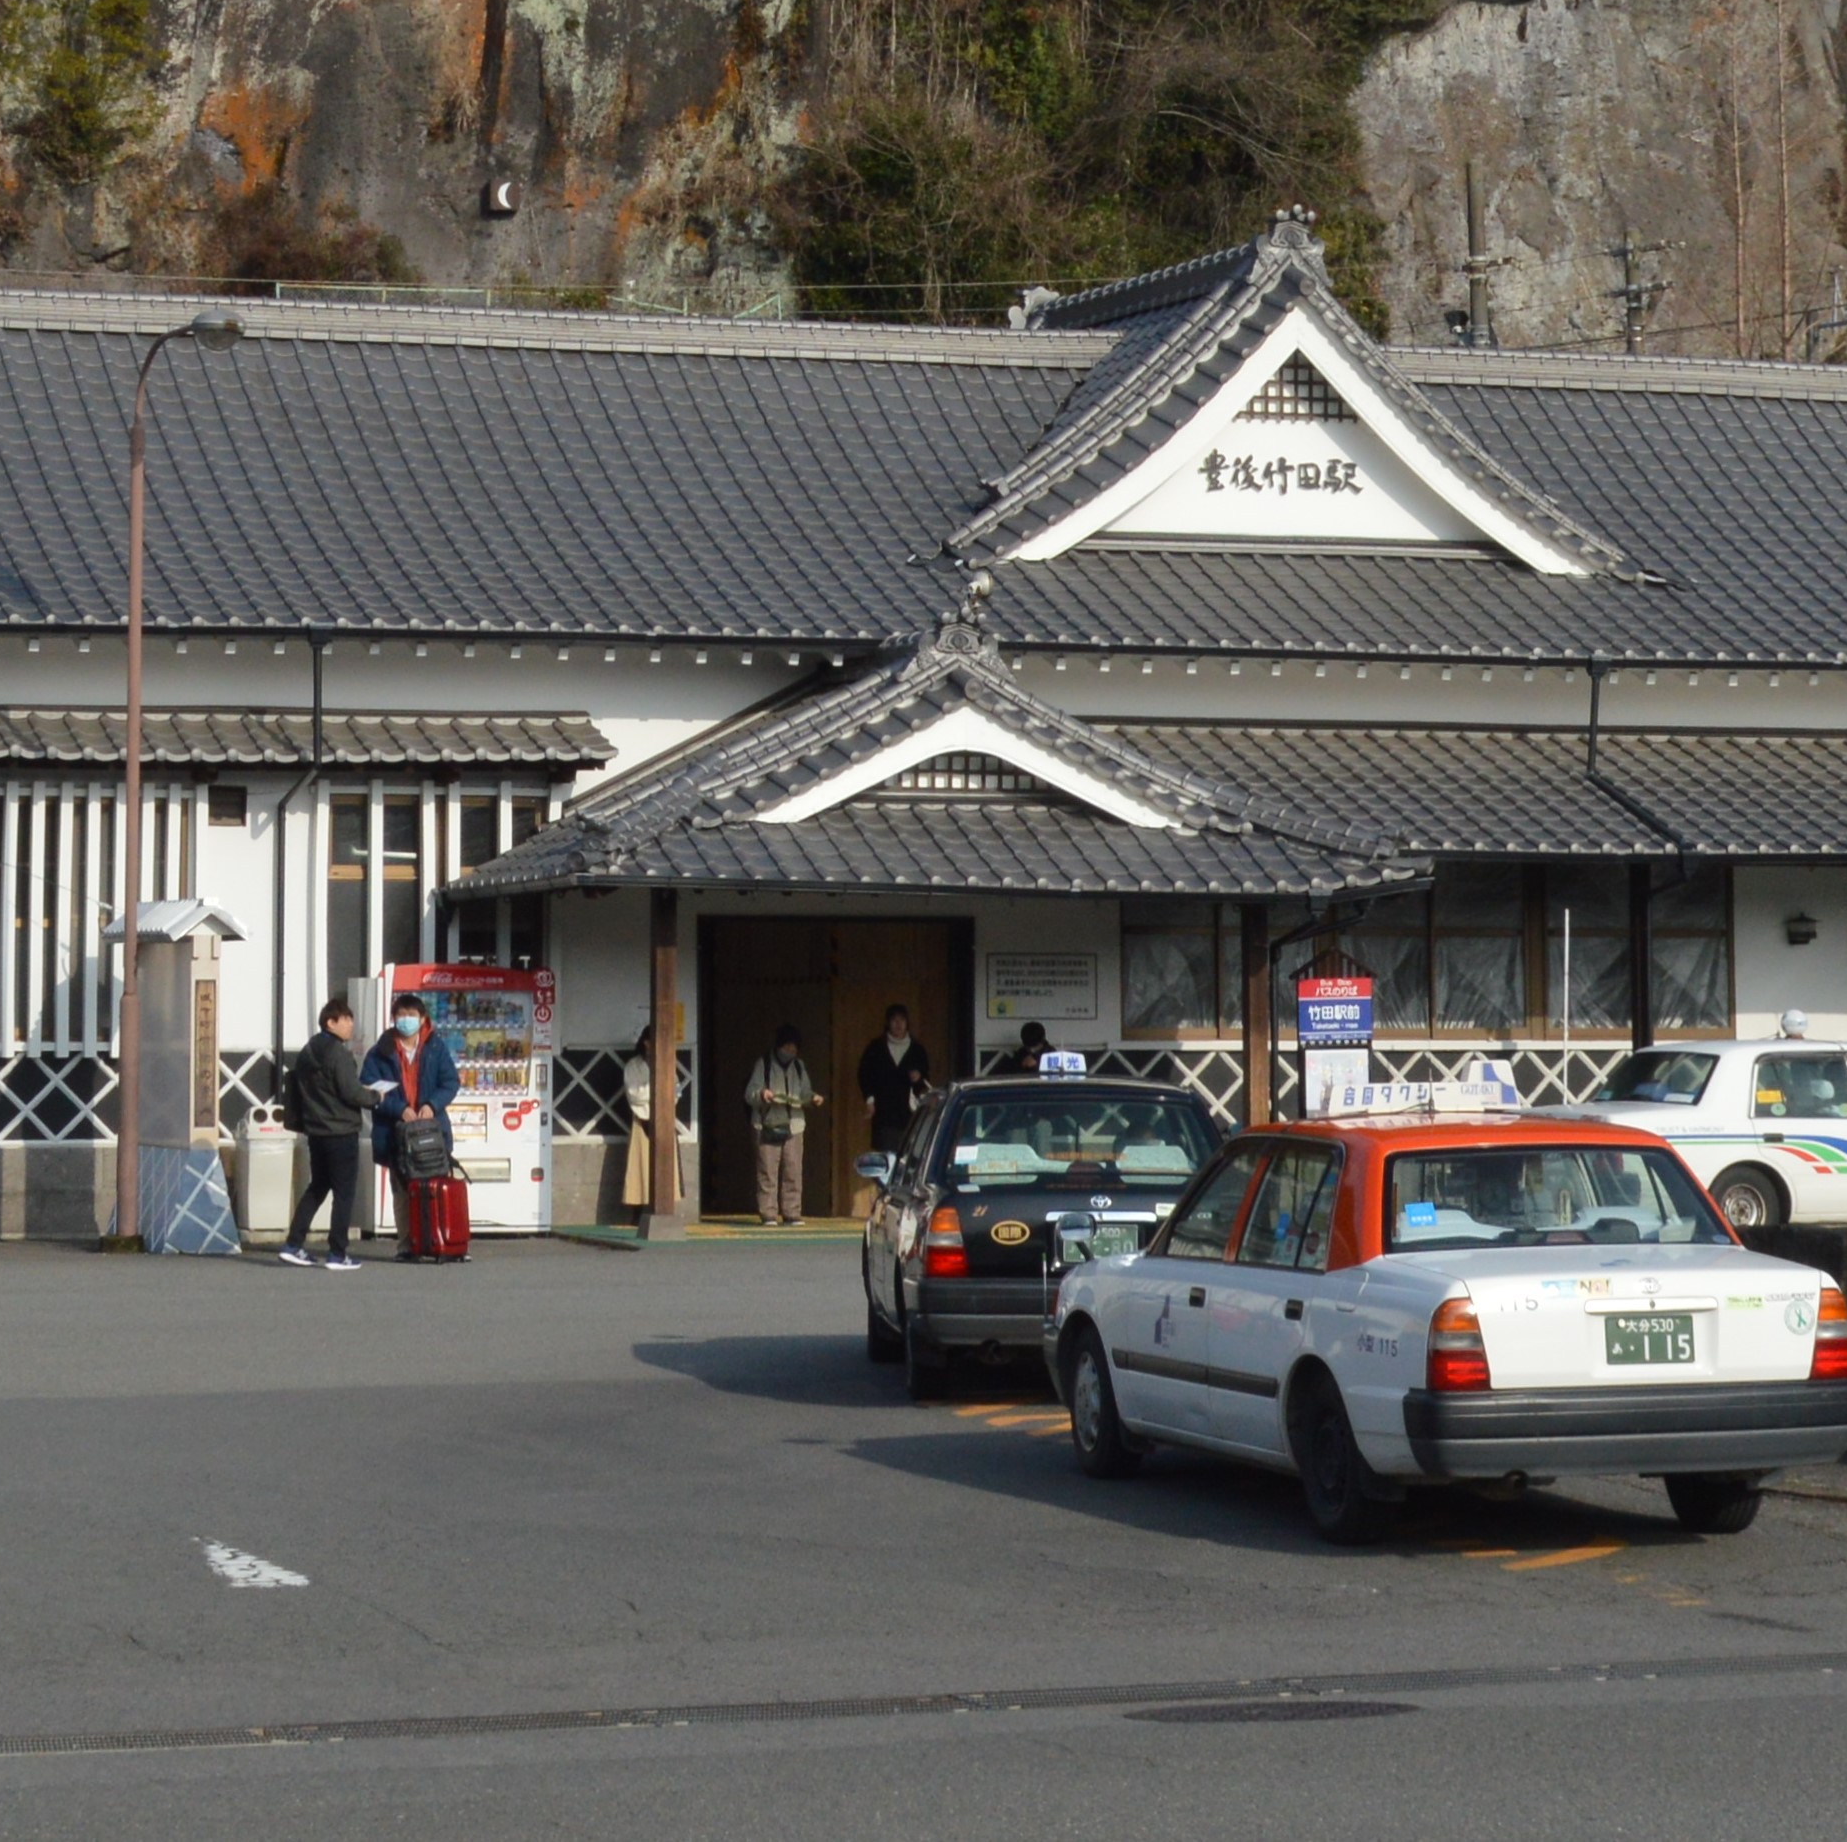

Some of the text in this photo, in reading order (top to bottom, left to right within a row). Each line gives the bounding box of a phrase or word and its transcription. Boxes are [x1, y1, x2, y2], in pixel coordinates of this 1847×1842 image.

[1198, 448, 1364, 496] 豊後竹田駅
[1316, 986, 1358, 996] バスのりば
[1308, 1004, 1360, 1021] 竹田駅前
[1047, 1056, 1080, 1069] 観光
[1343, 1085, 1447, 1106] 合同タクシー
[1626, 1318, 1674, 1333] 大分530
[1357, 1334, 1398, 1357] 小型 115
